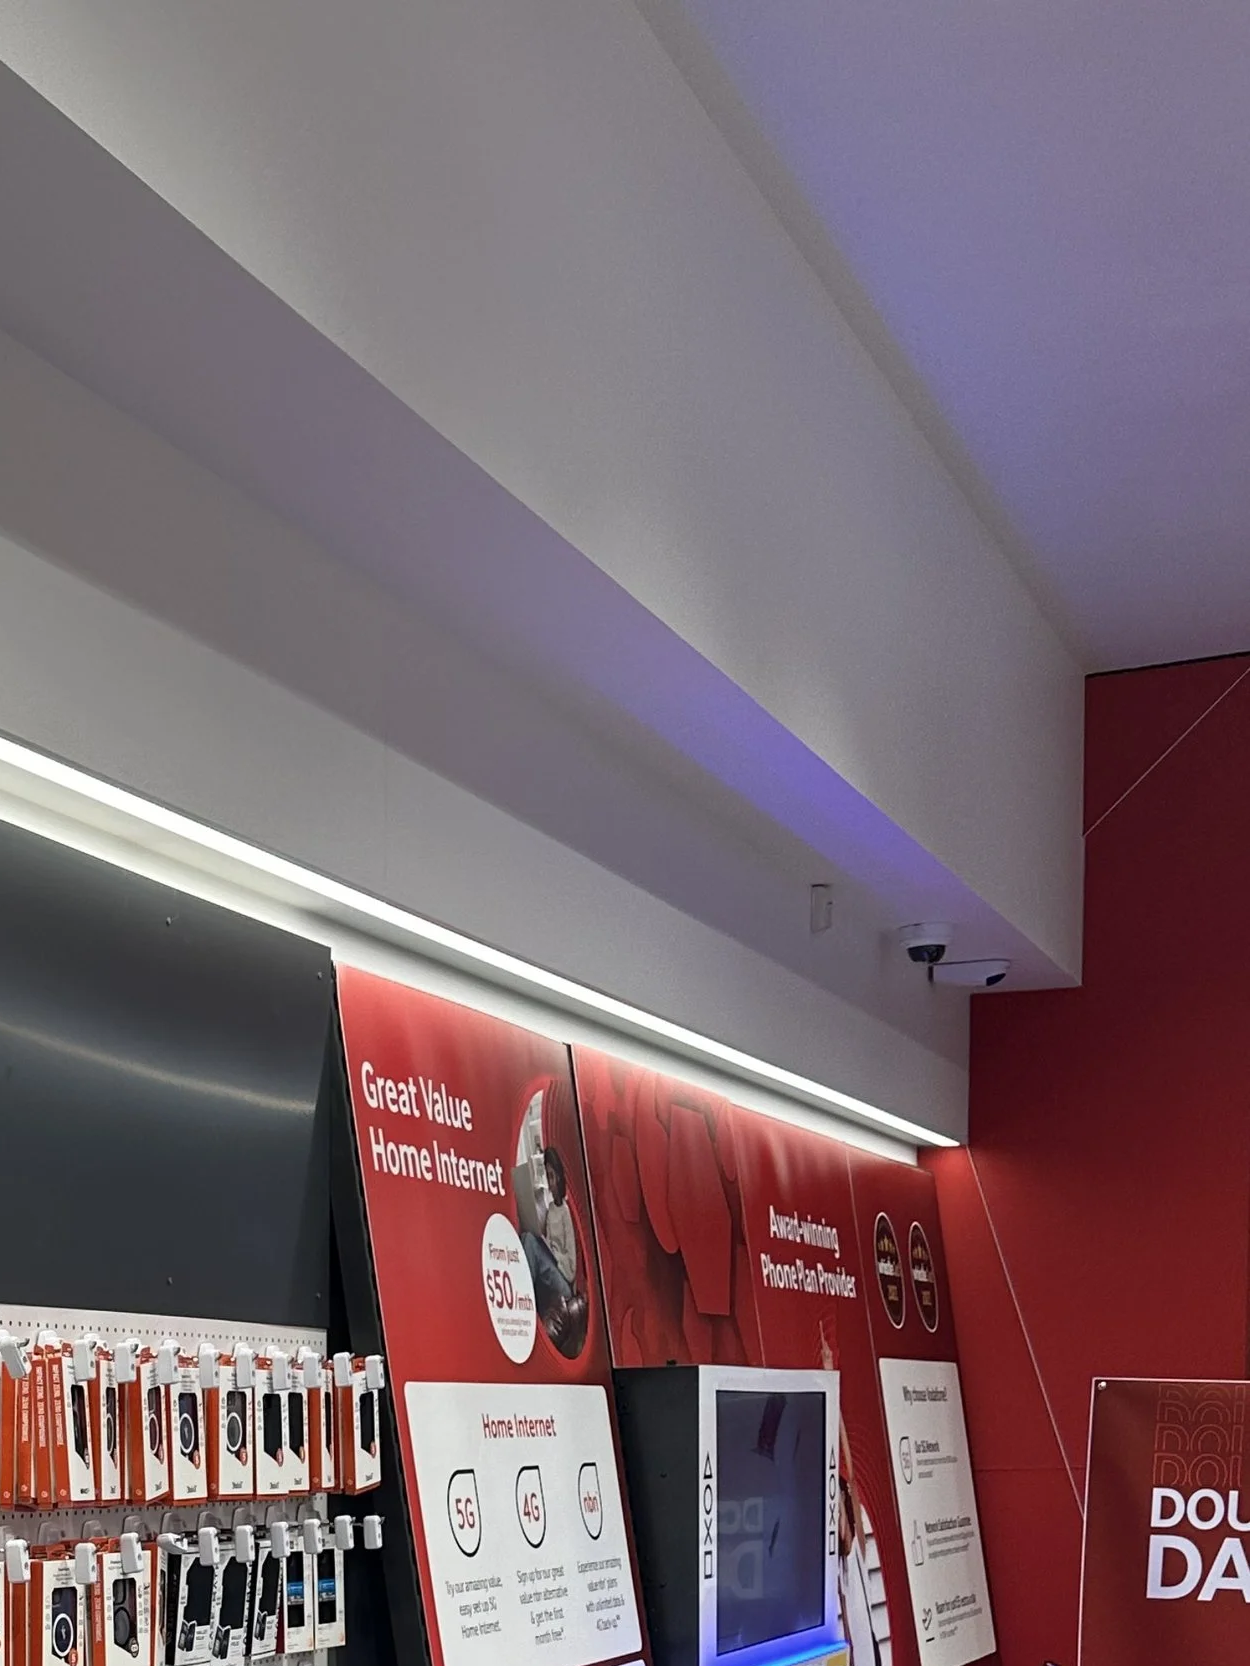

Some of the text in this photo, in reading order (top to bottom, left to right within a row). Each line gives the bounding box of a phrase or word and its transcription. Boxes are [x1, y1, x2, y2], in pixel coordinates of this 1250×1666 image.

[361, 1061, 473, 1131] Great Value
[368, 1126, 505, 1196] Home Internet
[489, 1243, 506, 1260] From
[769, 1205, 840, 1259] Award-winning
[486, 1268, 514, 1310] $50
[760, 1253, 799, 1290] Phone
[796, 1259, 818, 1294] Plan
[817, 1263, 857, 1298] Provider
[482, 1413, 556, 1439] Home Internet
[455, 1497, 476, 1529] 5G
[523, 1492, 540, 1522] 4G
[1150, 1487, 1250, 1532] DOU
[1146, 1534, 1250, 1604] DA
